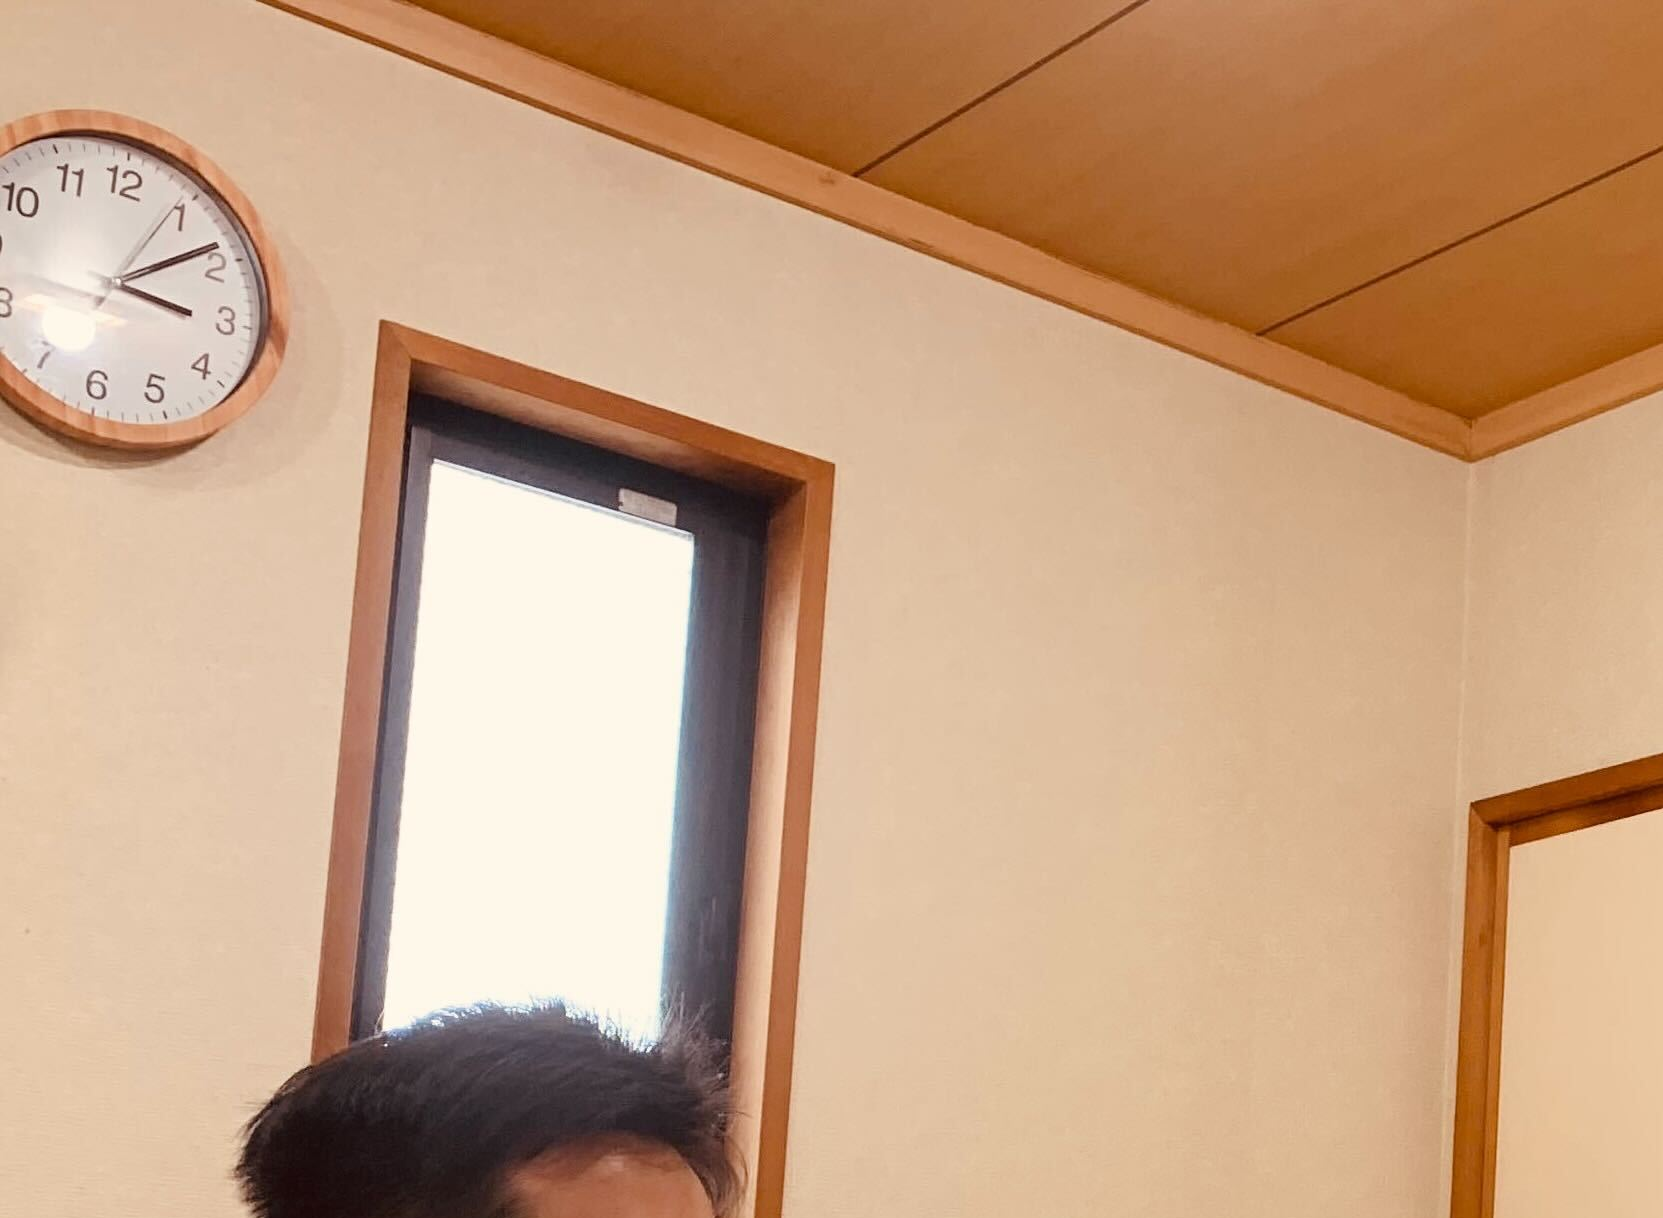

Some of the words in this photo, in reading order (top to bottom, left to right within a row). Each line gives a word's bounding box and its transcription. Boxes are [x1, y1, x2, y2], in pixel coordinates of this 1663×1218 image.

[56, 163, 85, 197] 11
[106, 164, 143, 202] 12
[2, 182, 39, 217] 10
[173, 203, 186, 231] 1
[204, 252, 227, 283] 2
[216, 306, 236, 335] 3
[37, 340, 55, 369] 7
[191, 352, 212, 380] 4
[86, 370, 109, 400] 6
[144, 373, 166, 403] 5
